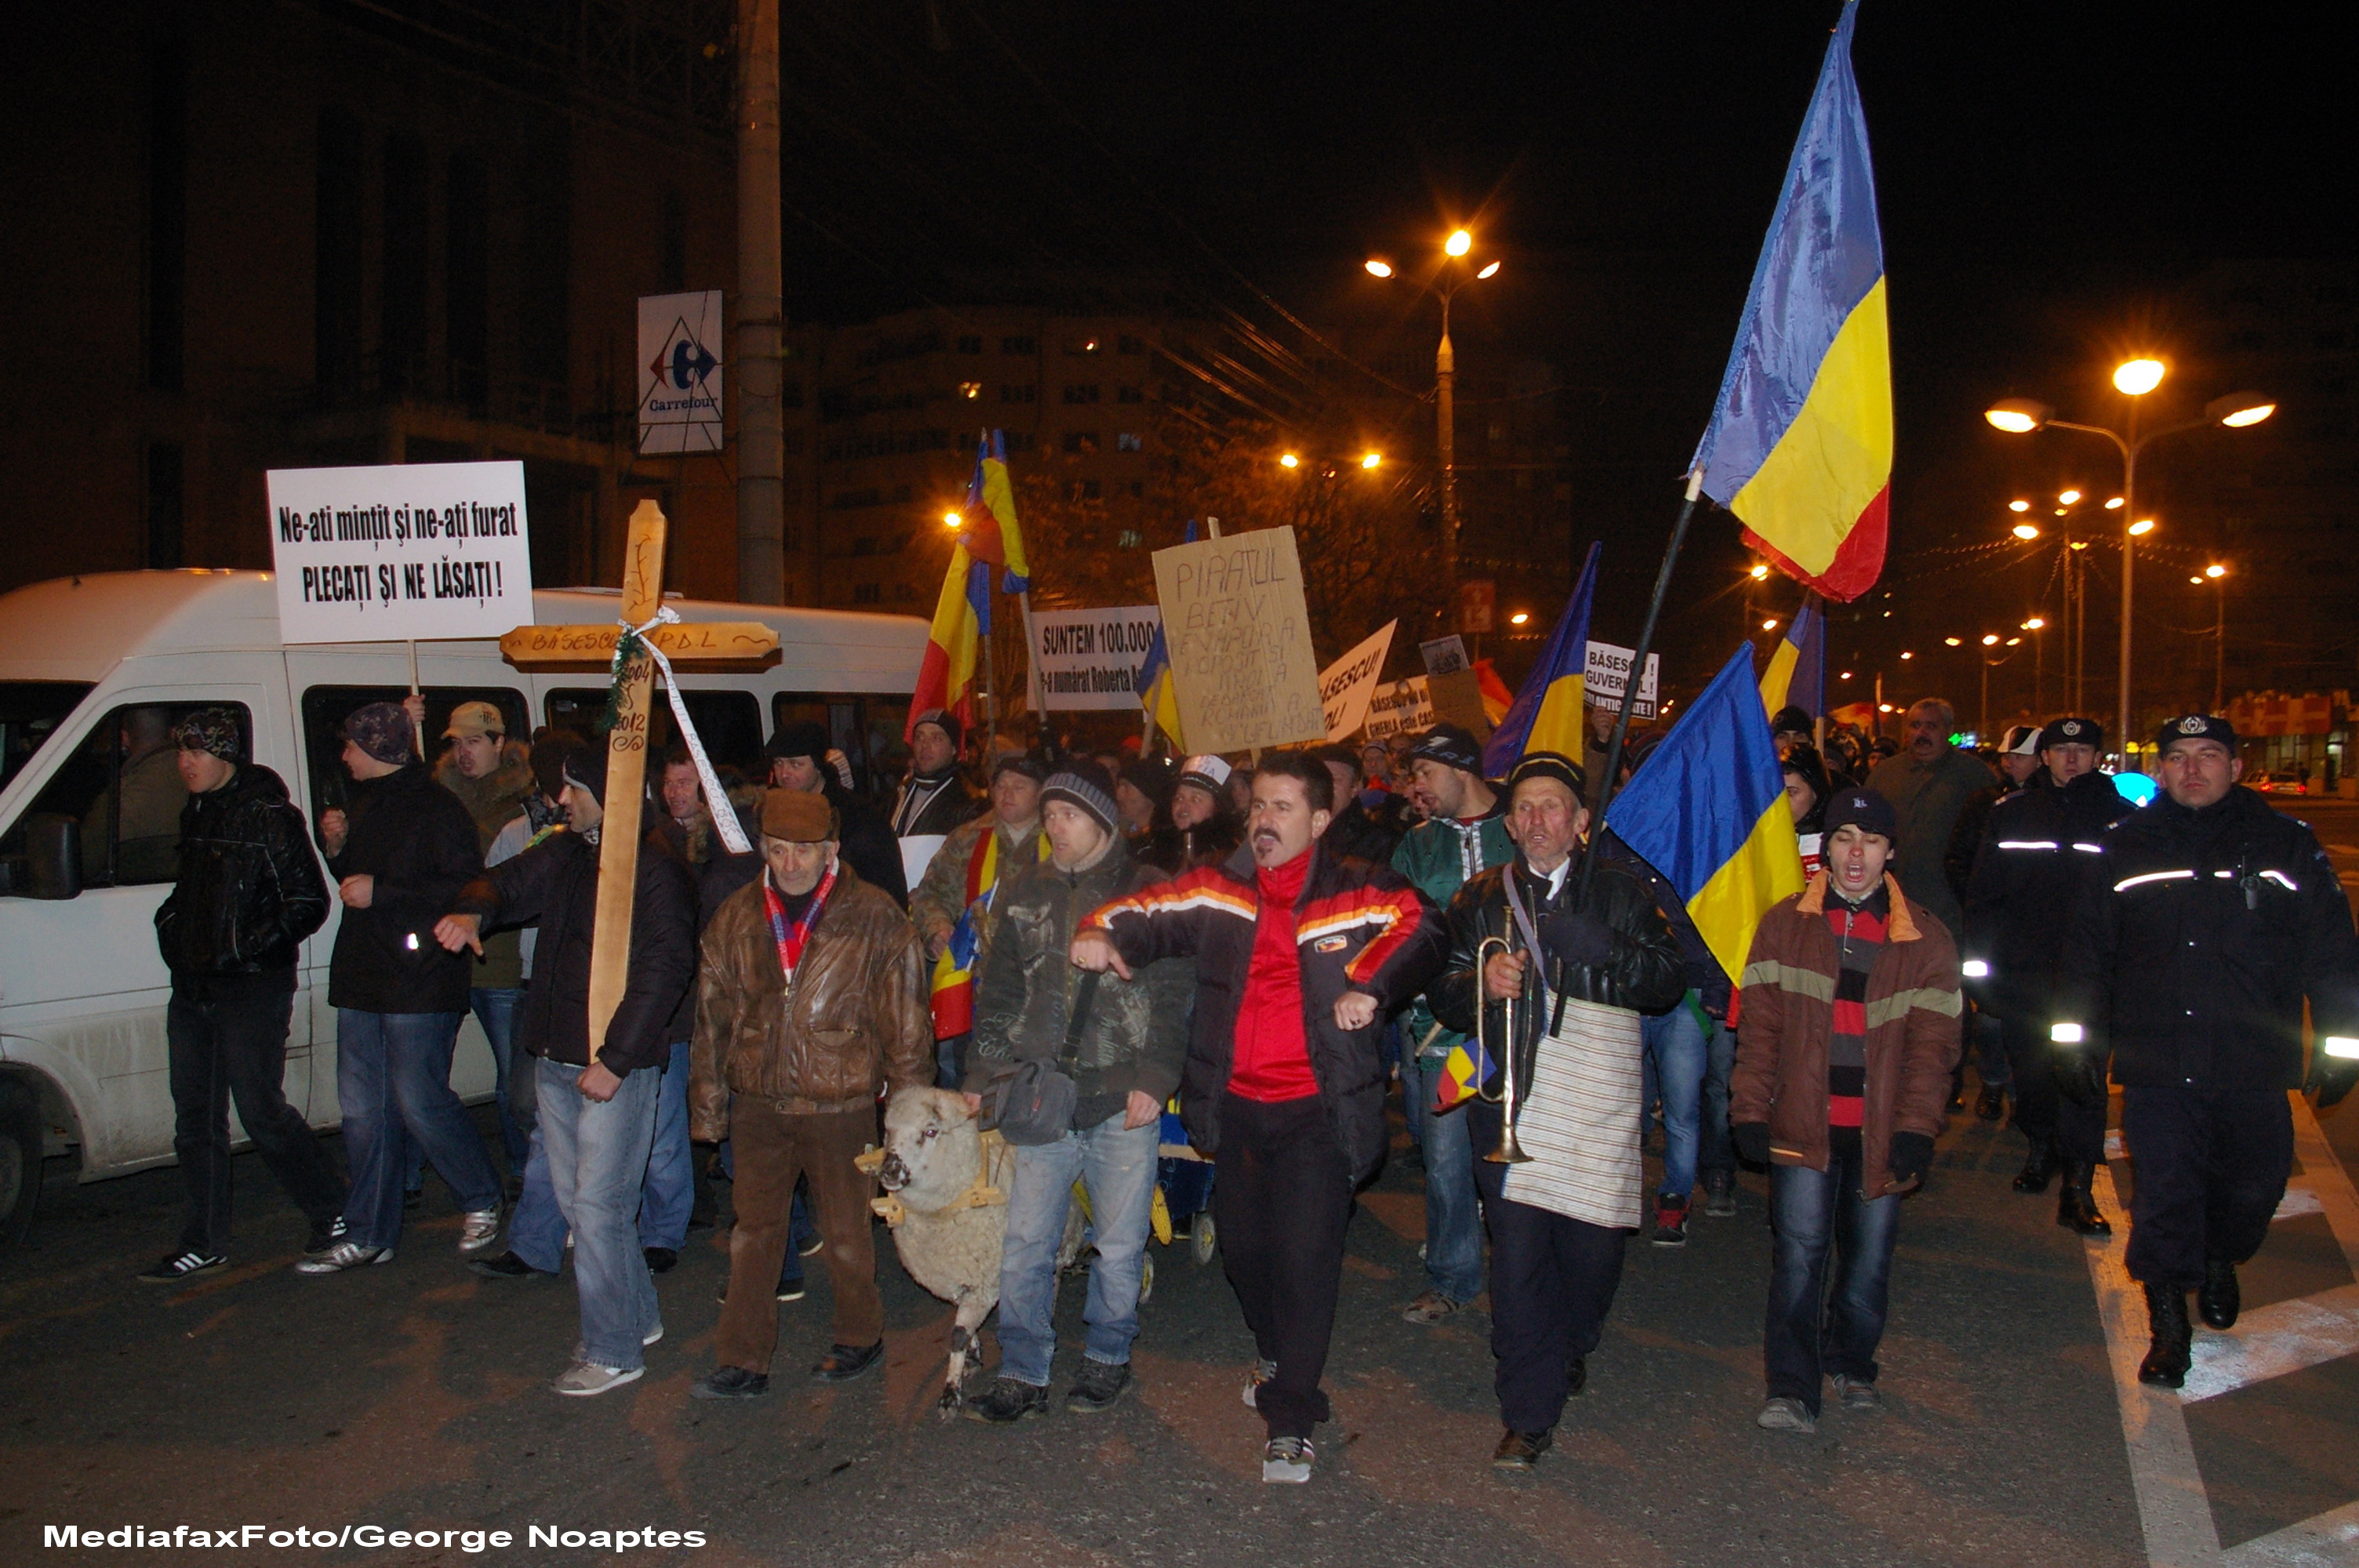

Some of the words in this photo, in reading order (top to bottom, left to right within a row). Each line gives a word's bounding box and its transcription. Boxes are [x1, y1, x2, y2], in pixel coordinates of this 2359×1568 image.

[649, 395, 718, 412] Carrefour
[279, 505, 335, 543] Ne-ati
[415, 501, 469, 549] ne-ați
[471, 501, 518, 538] furat
[303, 564, 373, 612] PLECAȚI
[404, 563, 427, 600] NE
[1176, 548, 1286, 602] PIRATUL
[1043, 624, 1095, 655] SUNTEM
[1100, 620, 1156, 654] 100.000
[627, 660, 650, 683] 004
[1092, 665, 1131, 694] Roberta
